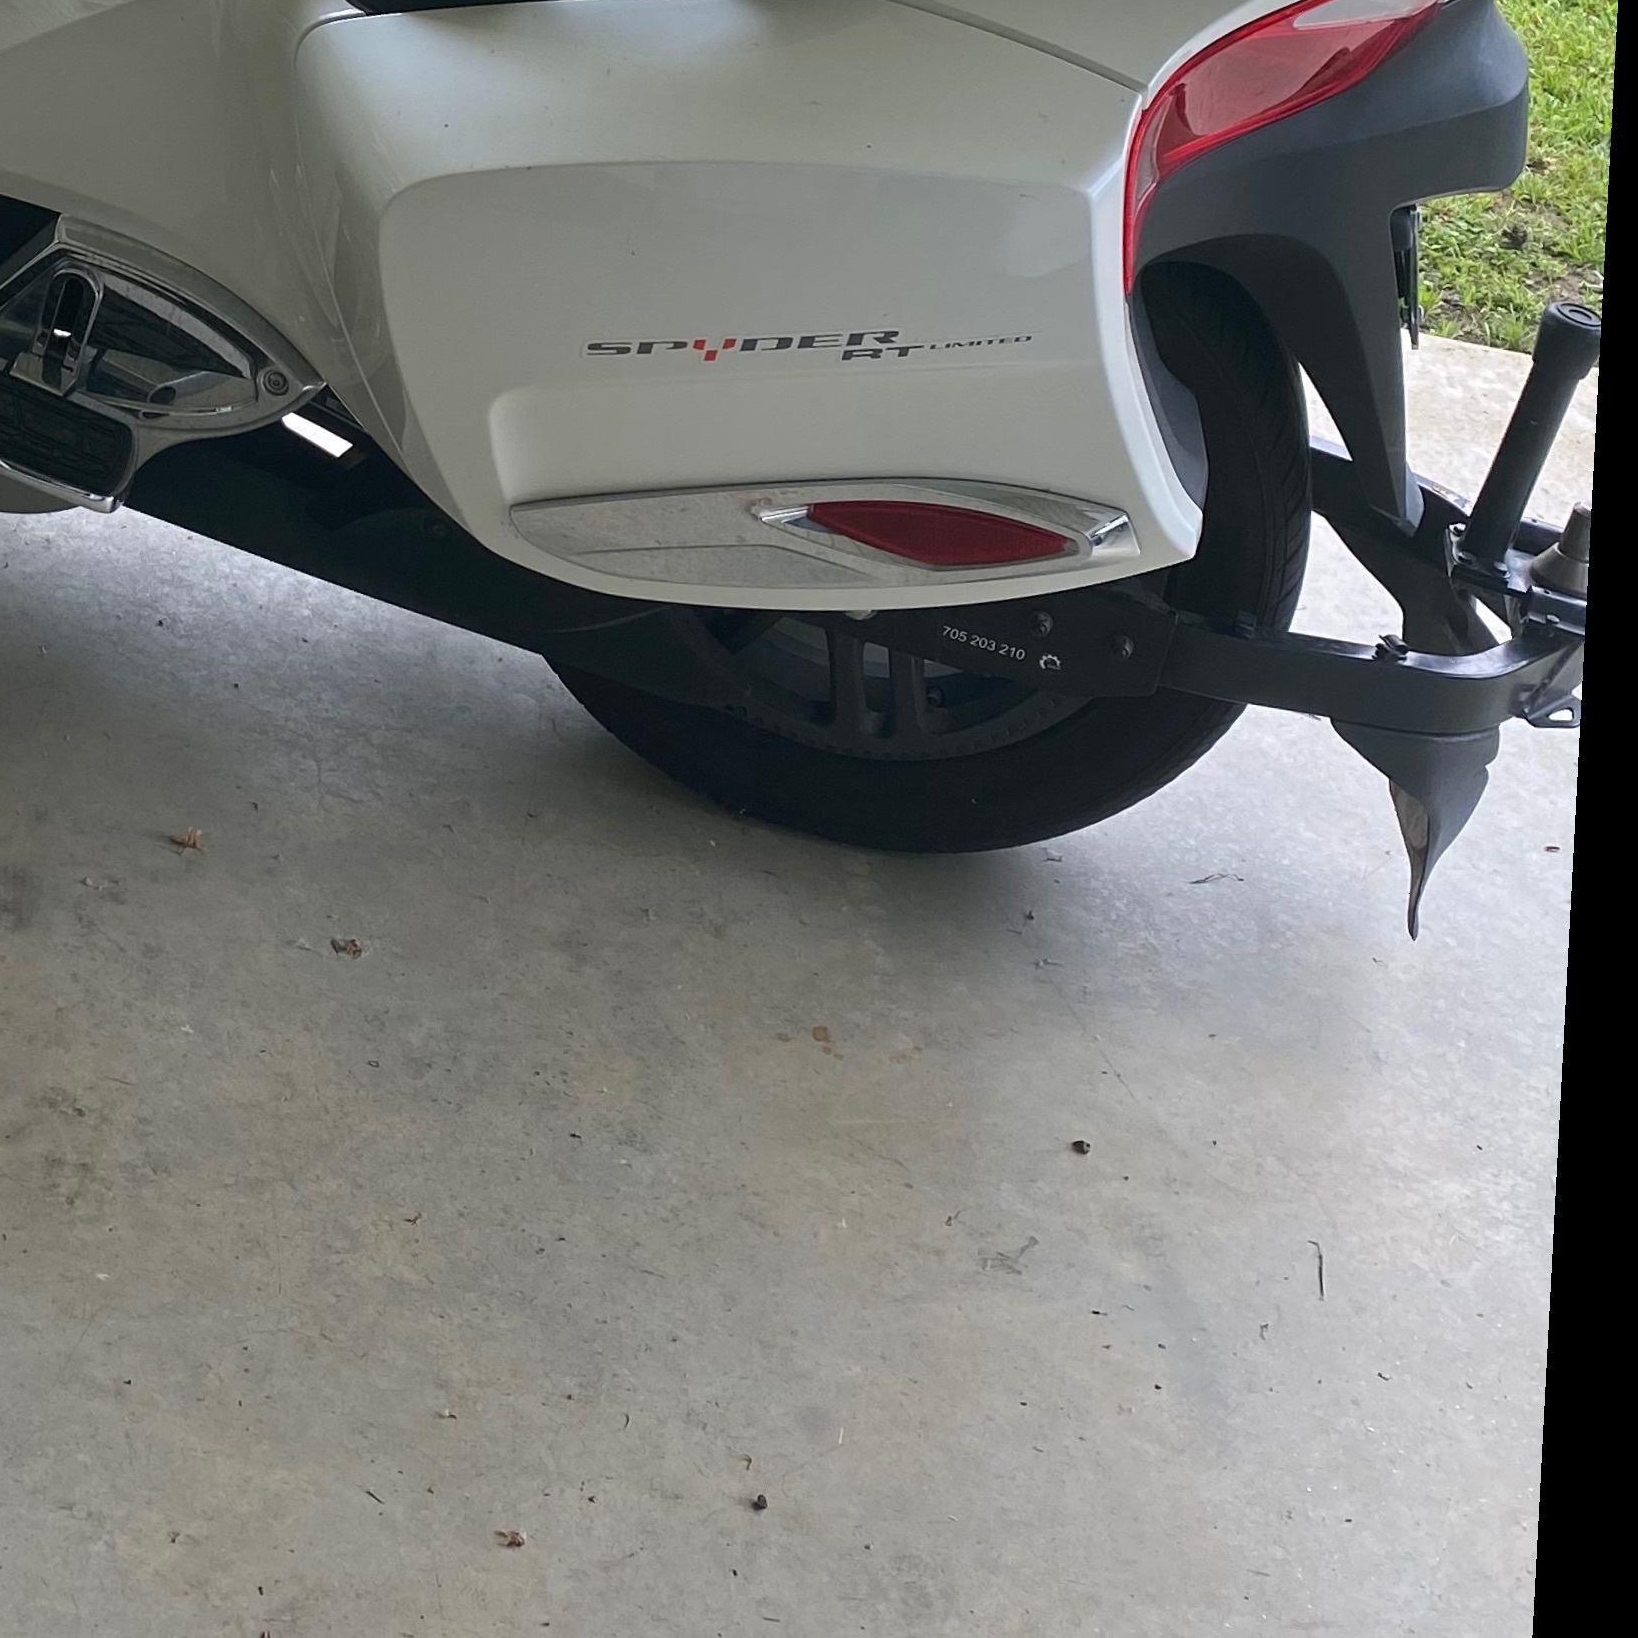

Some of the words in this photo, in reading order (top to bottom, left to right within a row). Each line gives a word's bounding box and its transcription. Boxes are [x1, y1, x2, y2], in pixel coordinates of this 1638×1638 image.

[585, 330, 900, 362] SPYDER
[841, 344, 925, 361] RT
[929, 335, 1033, 350] LIMITED
[942, 625, 968, 643] 705
[970, 634, 997, 652] 203
[999, 643, 1025, 661] 210
